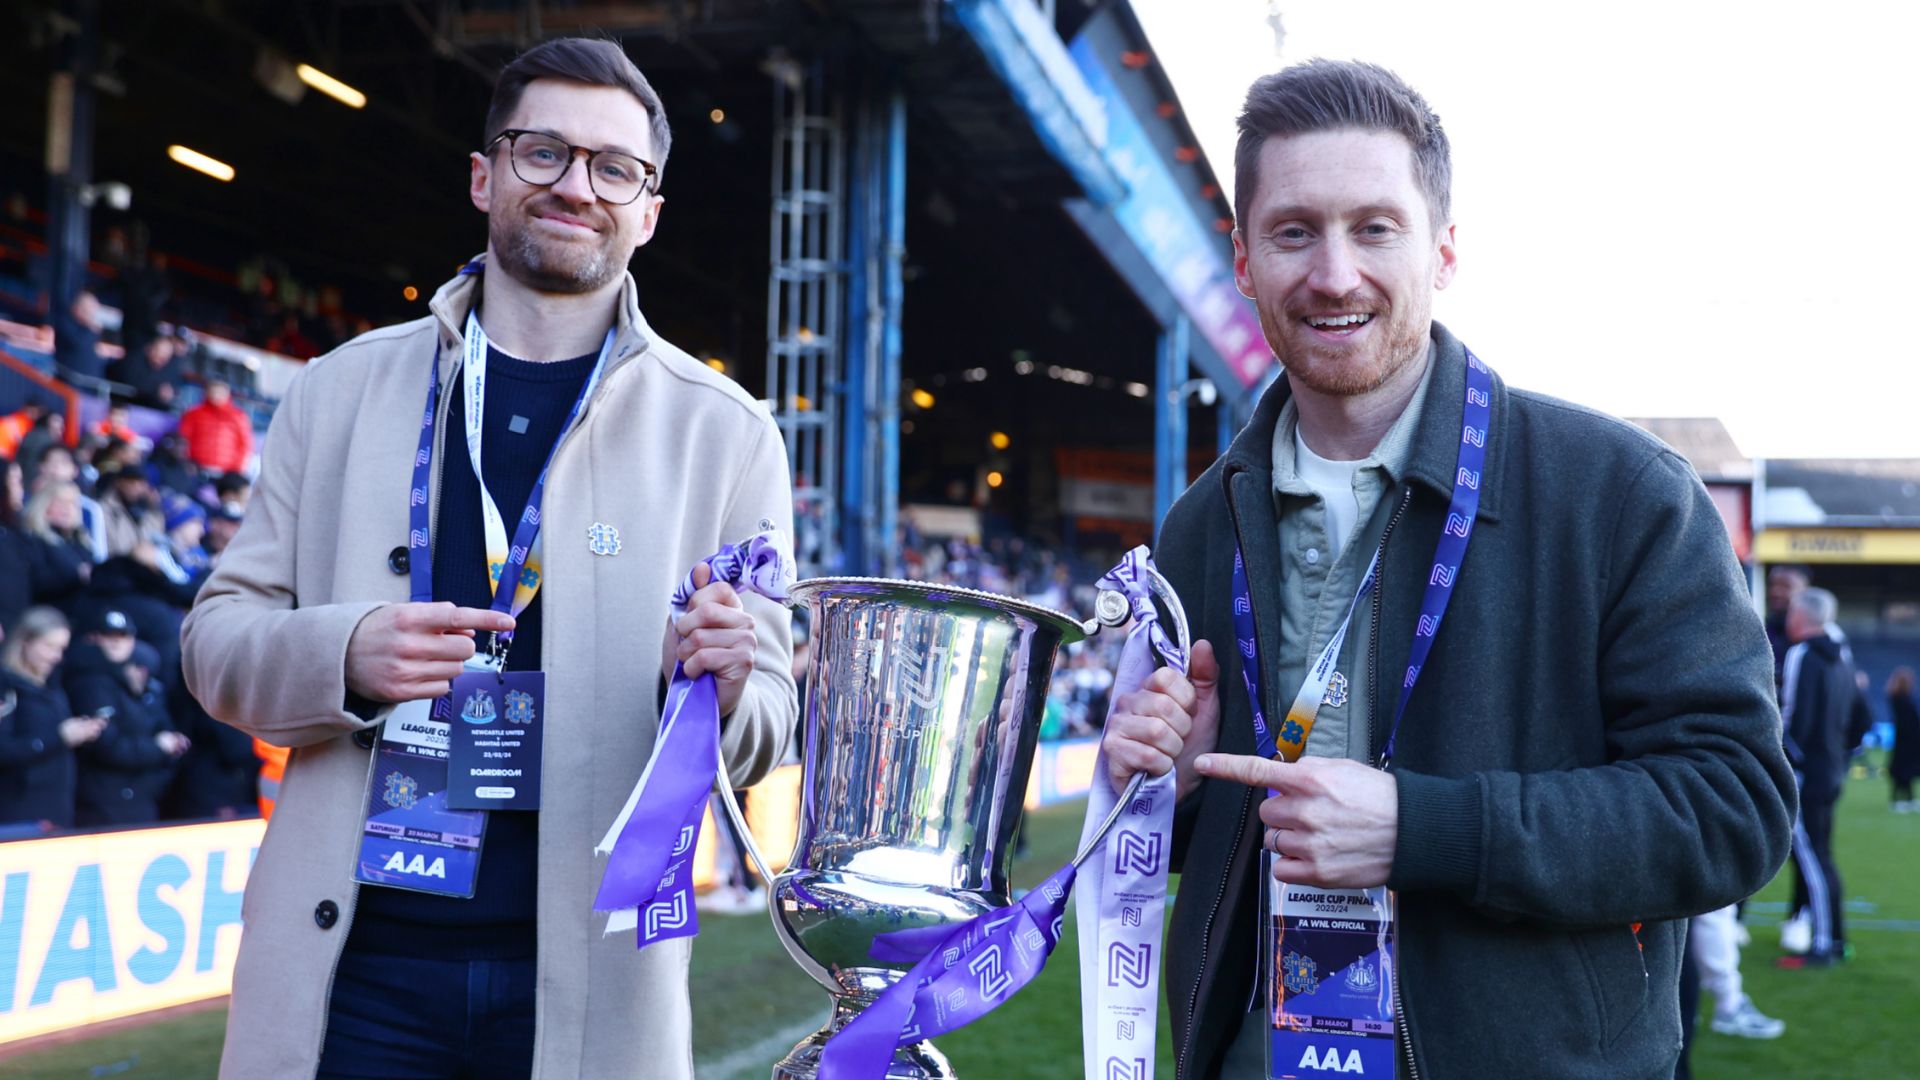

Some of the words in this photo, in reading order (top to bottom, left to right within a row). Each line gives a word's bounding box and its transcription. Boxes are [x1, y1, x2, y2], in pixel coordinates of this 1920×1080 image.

[401, 723, 437, 736] LEAGUE
[470, 768, 522, 777] BOARDROOM
[384, 850, 445, 879] AAA
[1288, 892, 1326, 904] LEAGUE
[1327, 894, 1346, 905] CUP
[1347, 895, 1375, 906] FINAL
[1315, 903, 1349, 913] 2023/24
[0, 847, 260, 1014] ASH
[1299, 918, 1309, 927] FA
[1310, 920, 1330, 928] WNL
[1331, 921, 1366, 931] OFFICIAL
[1324, 1020, 1349, 1028] MARCH
[1298, 1045, 1364, 1075] AAA
